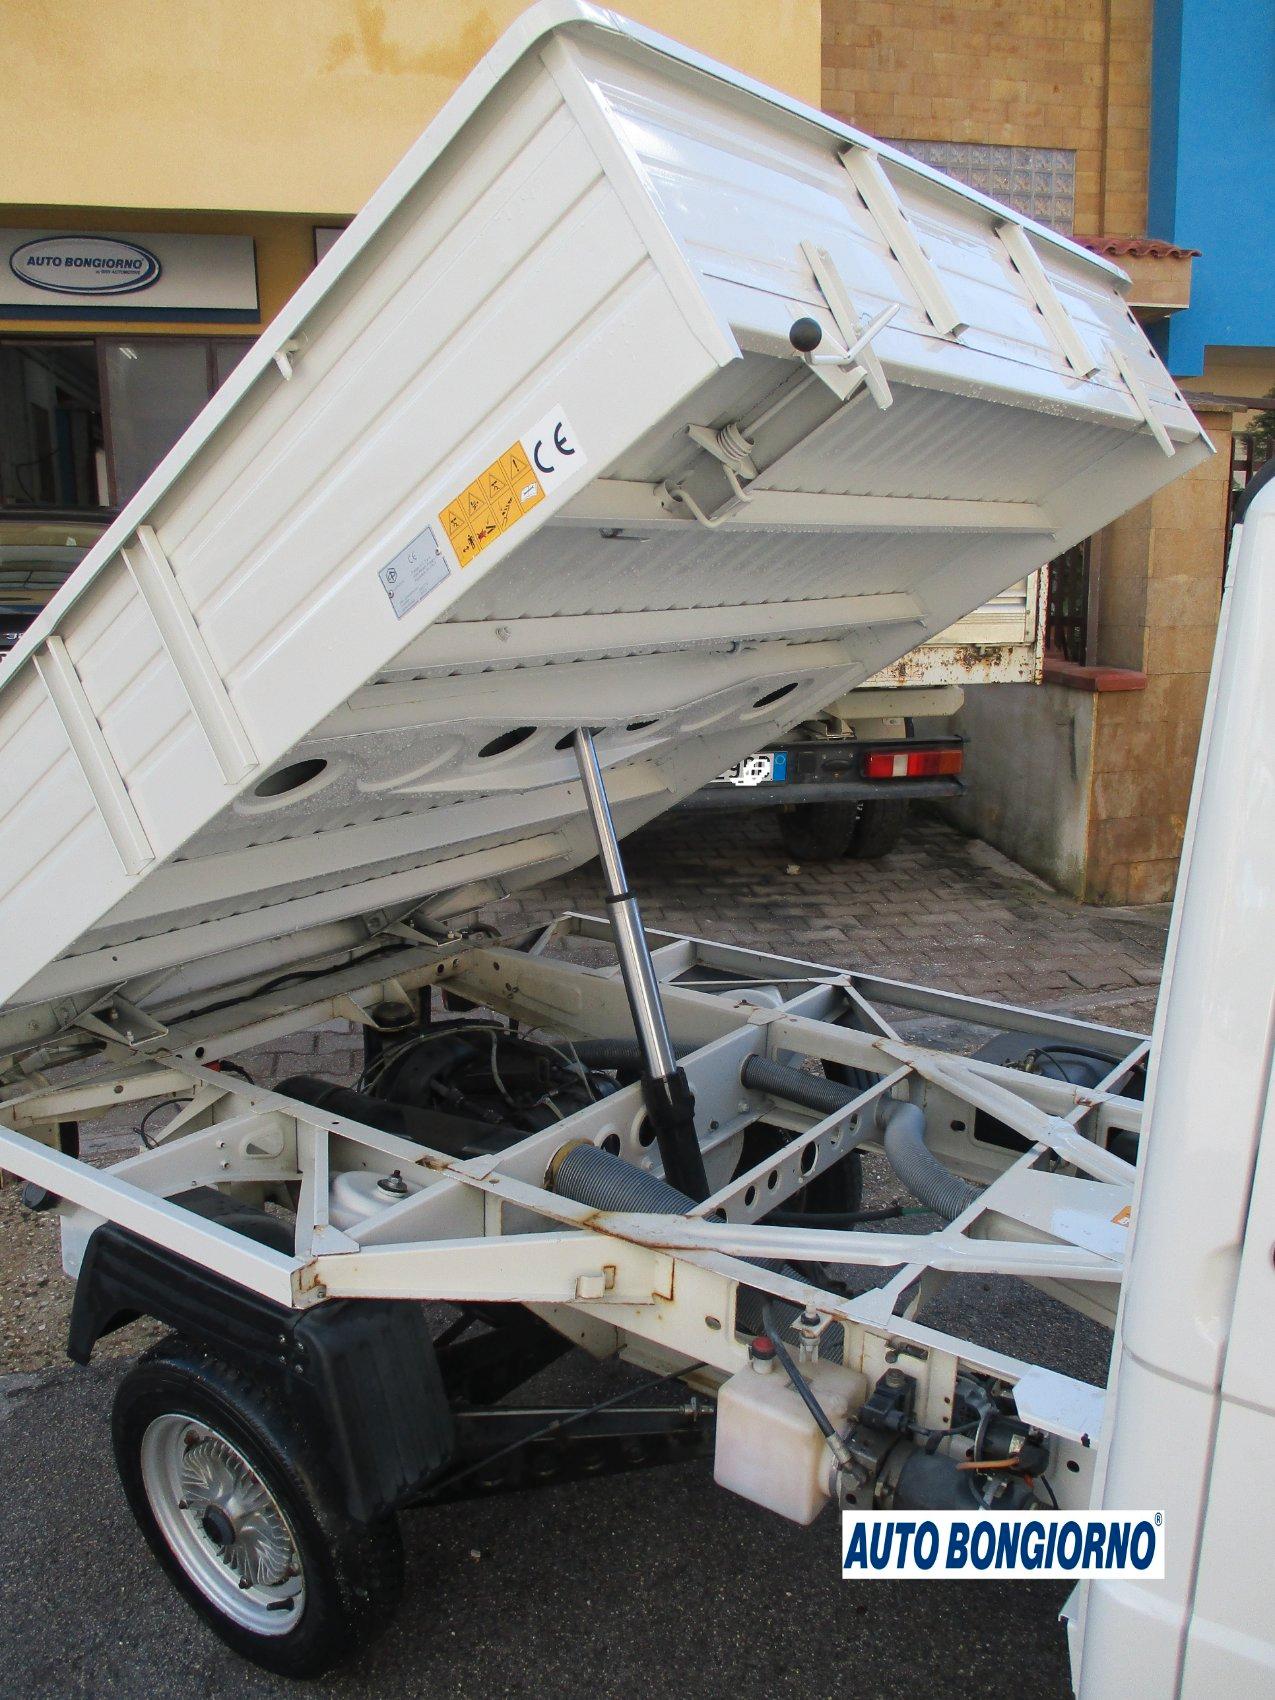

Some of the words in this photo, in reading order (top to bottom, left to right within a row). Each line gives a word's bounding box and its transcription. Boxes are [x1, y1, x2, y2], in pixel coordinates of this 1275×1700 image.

[26, 256, 62, 267] AUTO
[64, 257, 143, 269] BONGIORNO
[534, 421, 575, 473] CE
